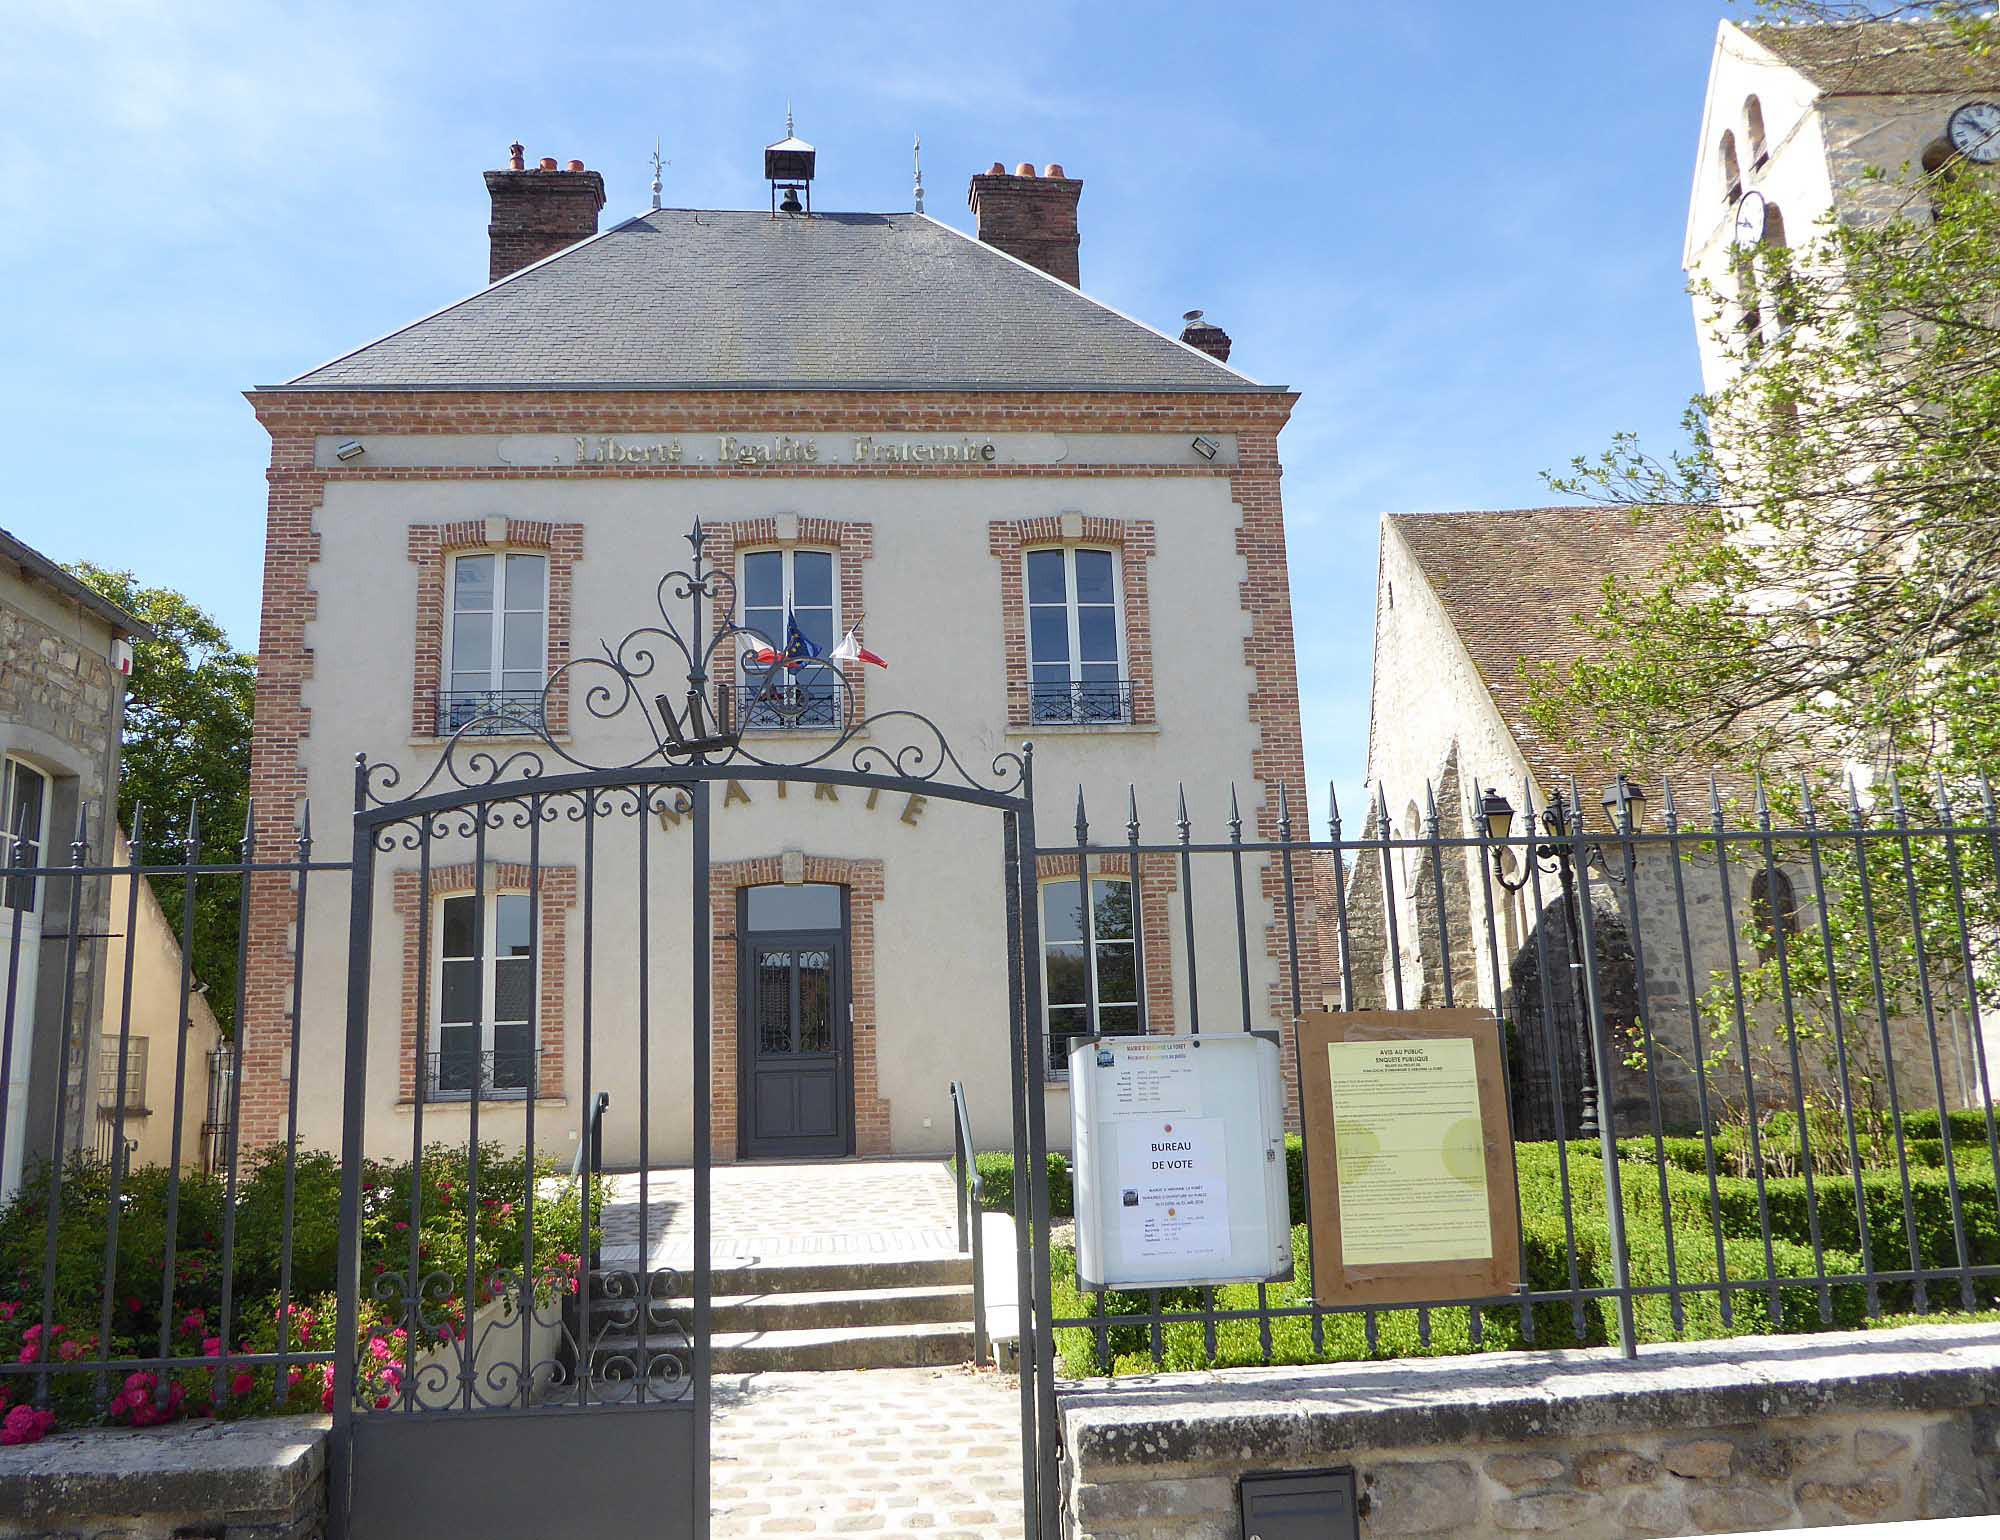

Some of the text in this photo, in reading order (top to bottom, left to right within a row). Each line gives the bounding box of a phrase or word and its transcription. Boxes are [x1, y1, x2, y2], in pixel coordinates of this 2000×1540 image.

[575, 437, 683, 463] Liberté
[853, 436, 996, 463] Fraternité
[1151, 1141, 1191, 1152] BUREAU
[1151, 1159, 1193, 1170] DE VOTE
